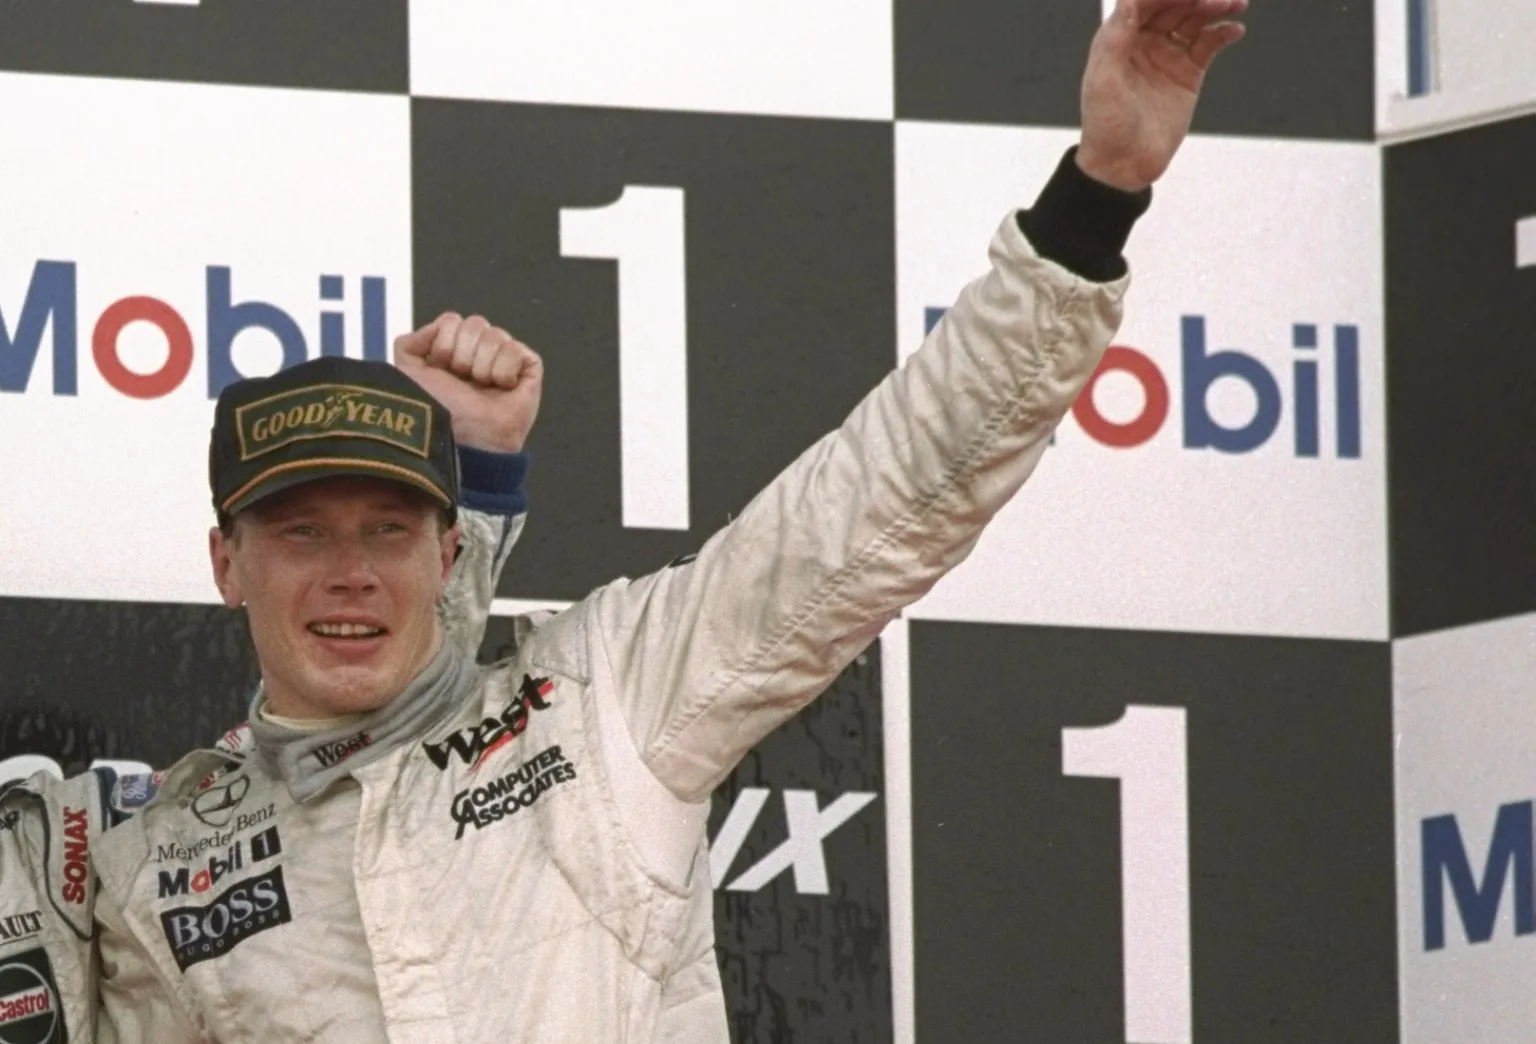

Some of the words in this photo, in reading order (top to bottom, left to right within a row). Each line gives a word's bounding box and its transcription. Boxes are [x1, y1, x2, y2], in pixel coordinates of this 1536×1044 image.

[559, 185, 690, 530] 1
[925, 306, 1361, 459] obil
[422, 673, 552, 771] West
[451, 745, 566, 823] COMPUTER
[62, 806, 89, 905] SONAX
[158, 841, 242, 899] Mobil
[170, 880, 279, 950] BOSS
